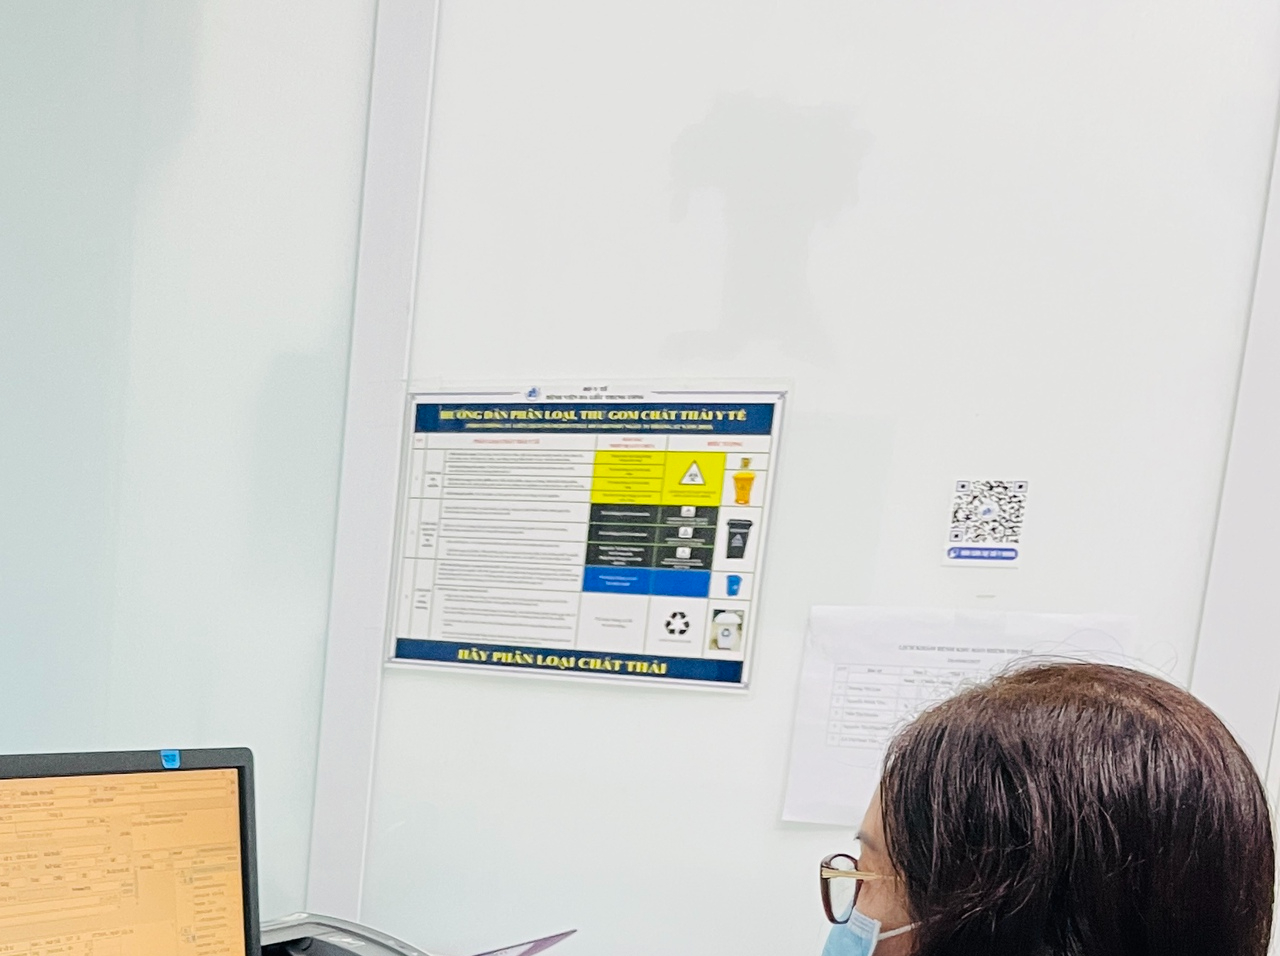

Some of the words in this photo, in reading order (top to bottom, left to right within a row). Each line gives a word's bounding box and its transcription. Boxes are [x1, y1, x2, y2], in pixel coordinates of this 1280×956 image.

[510, 407, 543, 420] PHÂN
[579, 409, 606, 420] THU
[608, 409, 639, 421] GOM
[640, 408, 678, 421] CHẤT
[680, 407, 714, 421] THẢI
[715, 409, 726, 421] Y
[727, 408, 747, 421] TẾ
[457, 647, 489, 661] HÃY
[491, 650, 534, 665] PHÂN
[536, 653, 576, 670] LOẠI
[578, 655, 623, 672] CHẤT
[624, 659, 668, 675] THẢI
